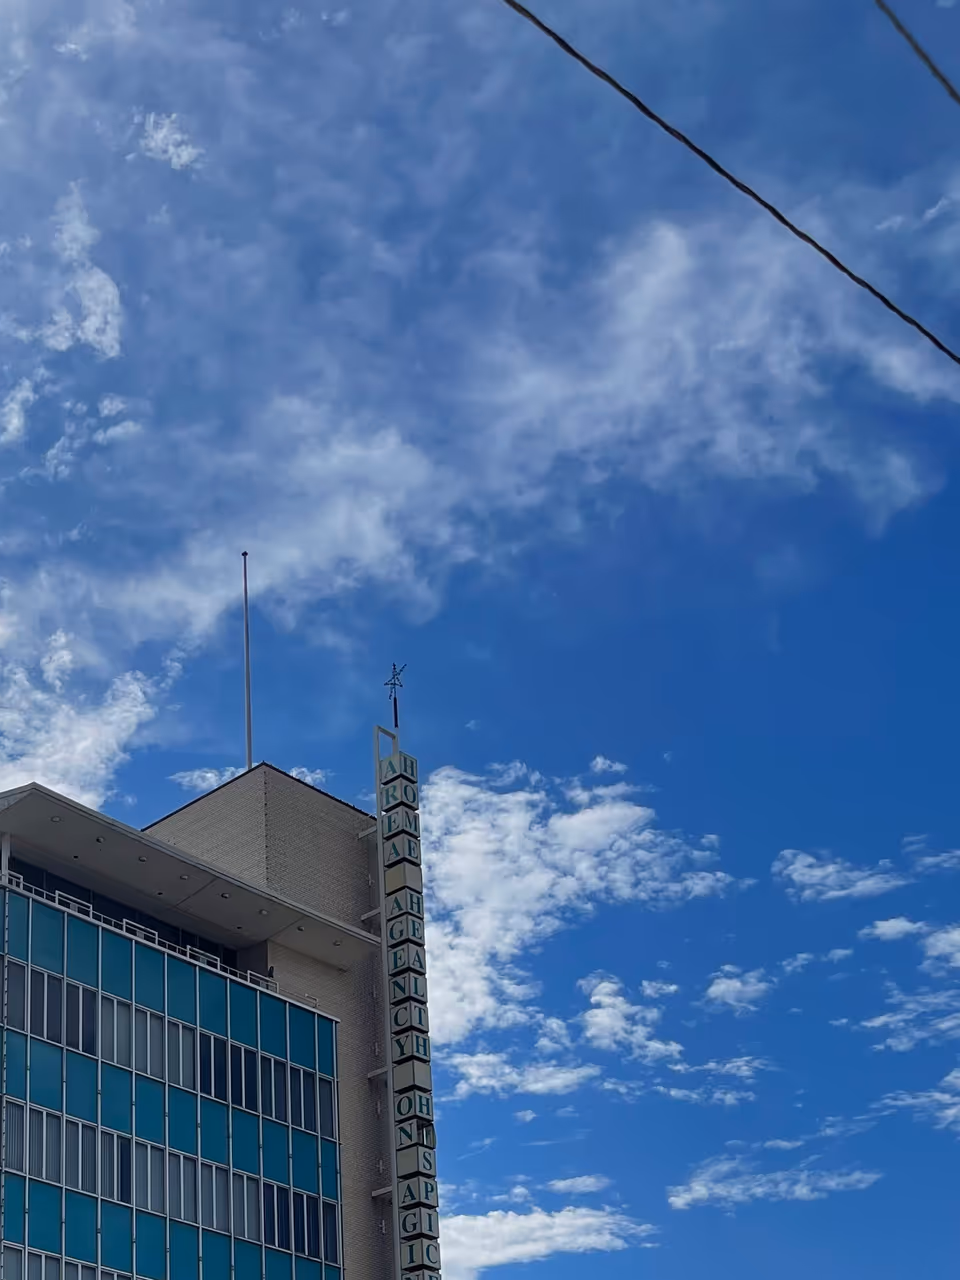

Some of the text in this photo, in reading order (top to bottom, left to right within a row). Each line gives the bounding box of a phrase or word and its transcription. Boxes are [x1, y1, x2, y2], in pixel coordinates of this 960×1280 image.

[384, 759, 401, 863] AREA
[402, 755, 419, 859] HOME
[389, 896, 410, 1058] AGENCY
[409, 893, 427, 1057] HEALTH
[396, 1095, 414, 1147] ON
